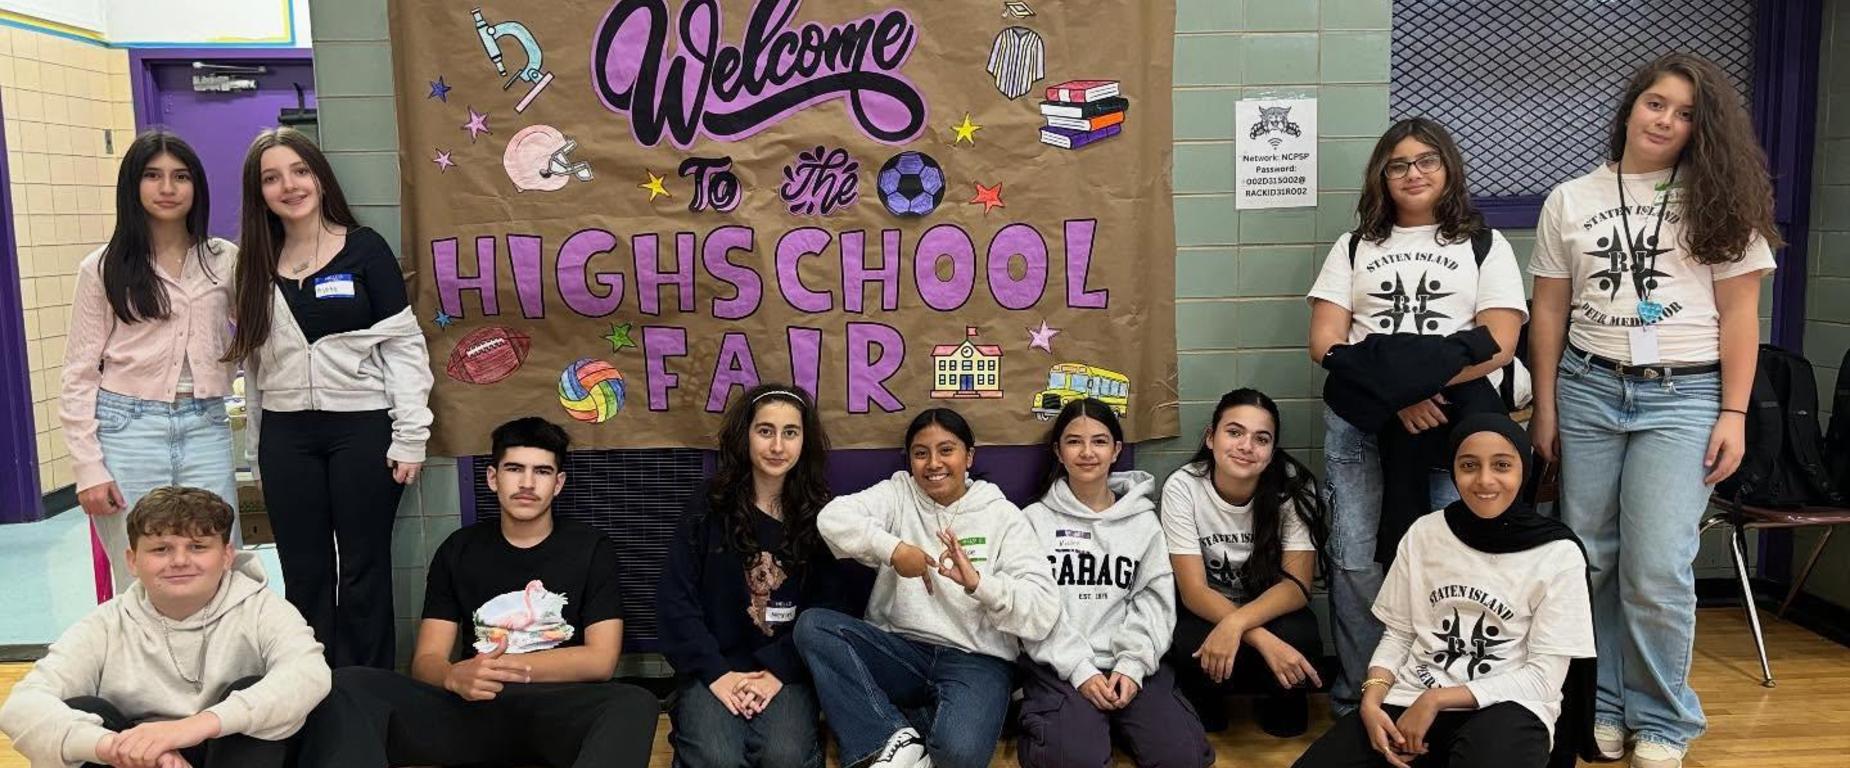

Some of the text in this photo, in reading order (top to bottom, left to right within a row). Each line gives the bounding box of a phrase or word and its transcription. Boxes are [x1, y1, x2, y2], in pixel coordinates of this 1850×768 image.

[594, 0, 925, 147] Welcome
[1243, 153, 1310, 162] Network: NCPSP
[1256, 165, 1297, 173] Password:
[1584, 205, 1681, 230] STATEN ISLND
[1367, 253, 1458, 272] STATEN ISLAND
[1582, 301, 1683, 327] PEER MEDIOR
[641, 321, 906, 414] FAIR
[1047, 554, 1140, 590] ARAG
[1429, 585, 1514, 621] STATEN ISLAND
